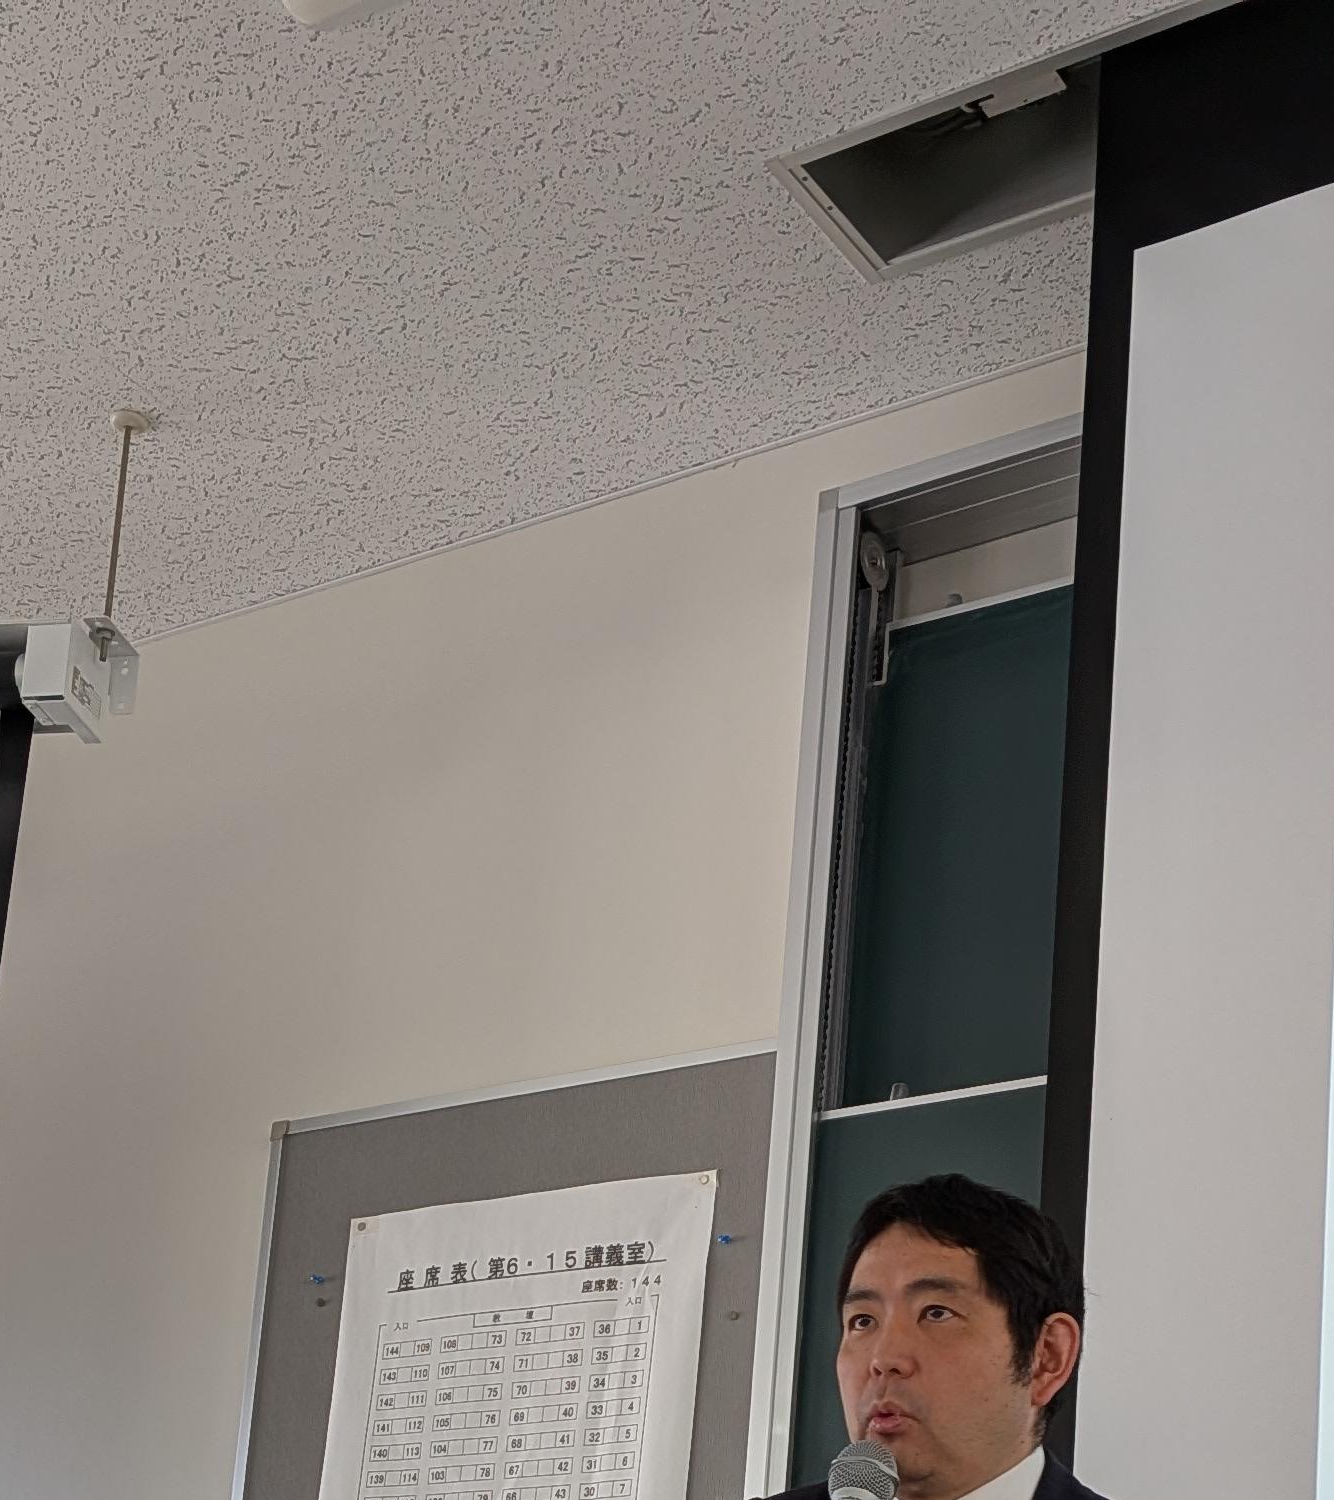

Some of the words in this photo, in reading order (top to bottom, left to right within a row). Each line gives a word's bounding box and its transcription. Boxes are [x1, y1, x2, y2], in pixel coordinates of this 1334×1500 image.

[382, 1371, 397, 1382] 143
[414, 1368, 428, 1379] 110
[440, 1365, 455, 1376] 107
[489, 1360, 500, 1372] 74
[518, 1357, 529, 1369] 71
[566, 1352, 579, 1364] 38
[595, 1350, 609, 1362] 35
[372, 1448, 388, 1459] 140
[406, 1446, 420, 1457] 113
[433, 1444, 447, 1455] 104
[482, 1440, 494, 1452] 77
[510, 1438, 523, 1449] 68
[559, 1433, 570, 1445] 41
[588, 1431, 601, 1443] 32
[554, 1488, 567, 1499] 43
